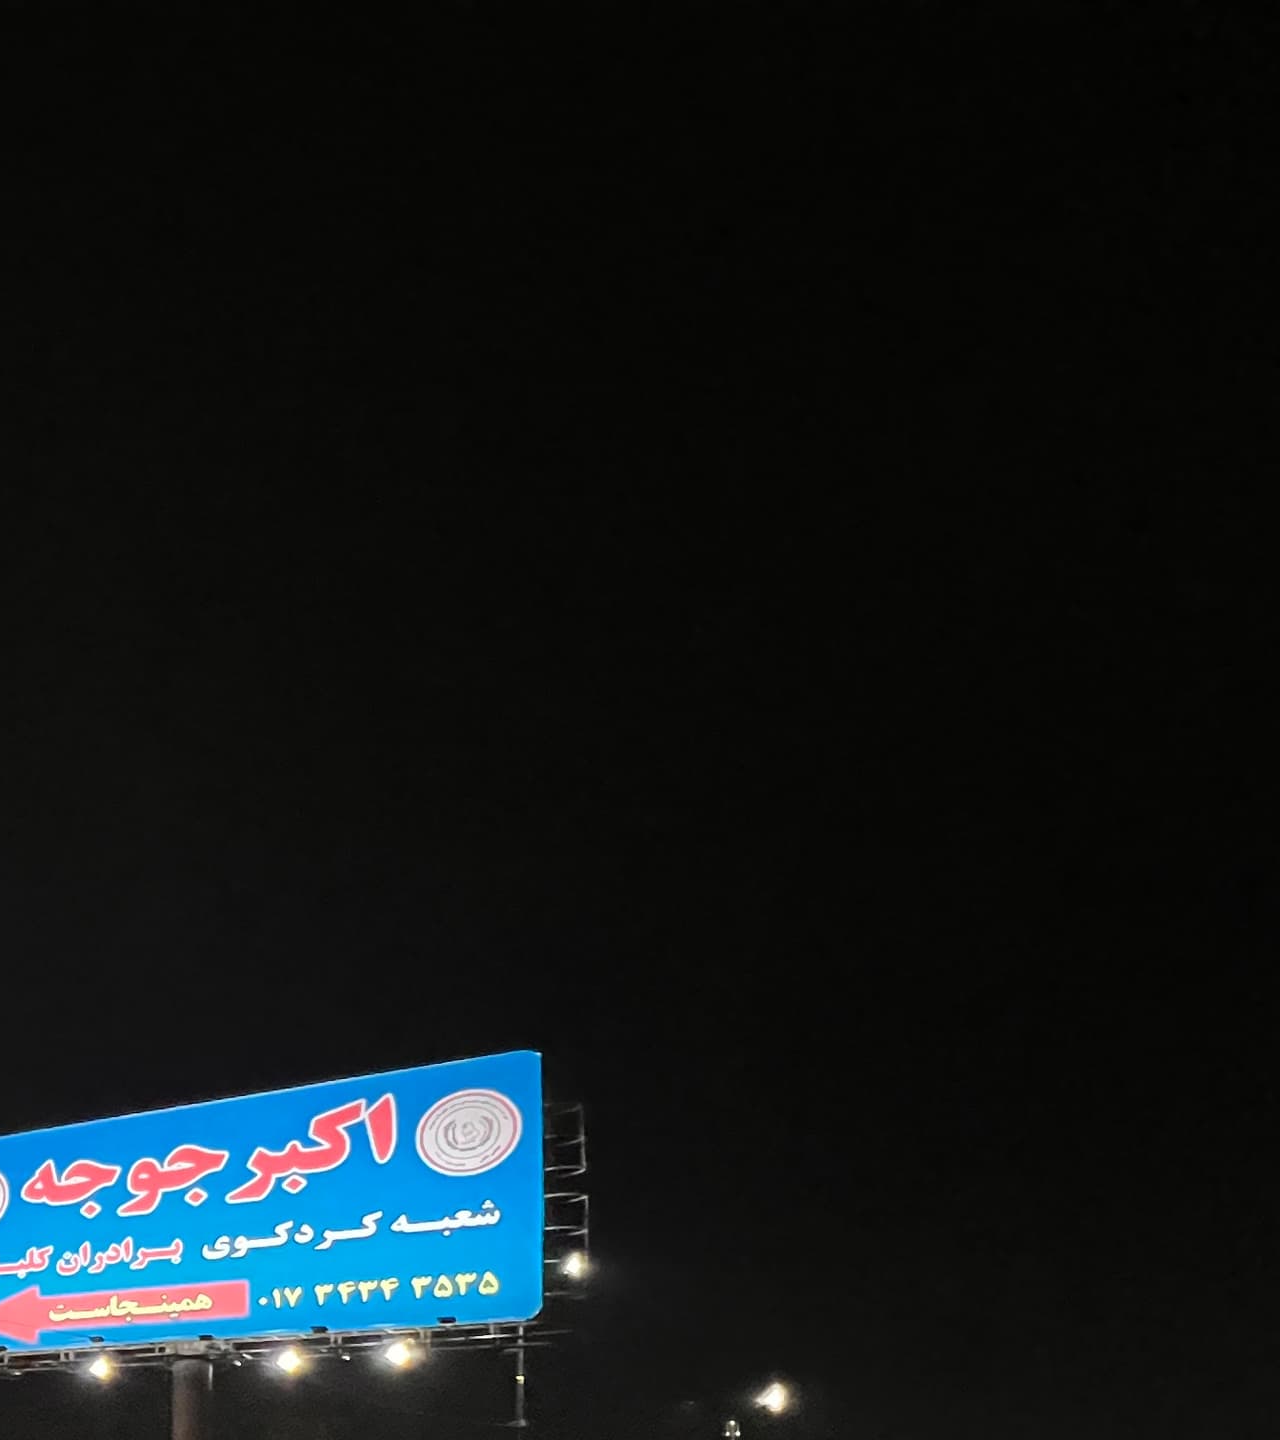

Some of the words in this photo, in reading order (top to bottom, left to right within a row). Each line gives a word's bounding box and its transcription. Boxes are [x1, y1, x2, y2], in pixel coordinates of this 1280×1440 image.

[224, 1092, 397, 1204] اکبر
[20, 1144, 230, 1218] جوجه
[201, 1210, 384, 1260] کردکوی
[390, 1199, 502, 1237] شعبه
[56, 1236, 184, 1275] برادران
[47, 1292, 214, 1323] همینجاست
[257, 1285, 303, 1310] ۰۱۷
[313, 1276, 400, 1307] ۳۴۳۴
[410, 1269, 500, 1300] ۳۵۳۵
